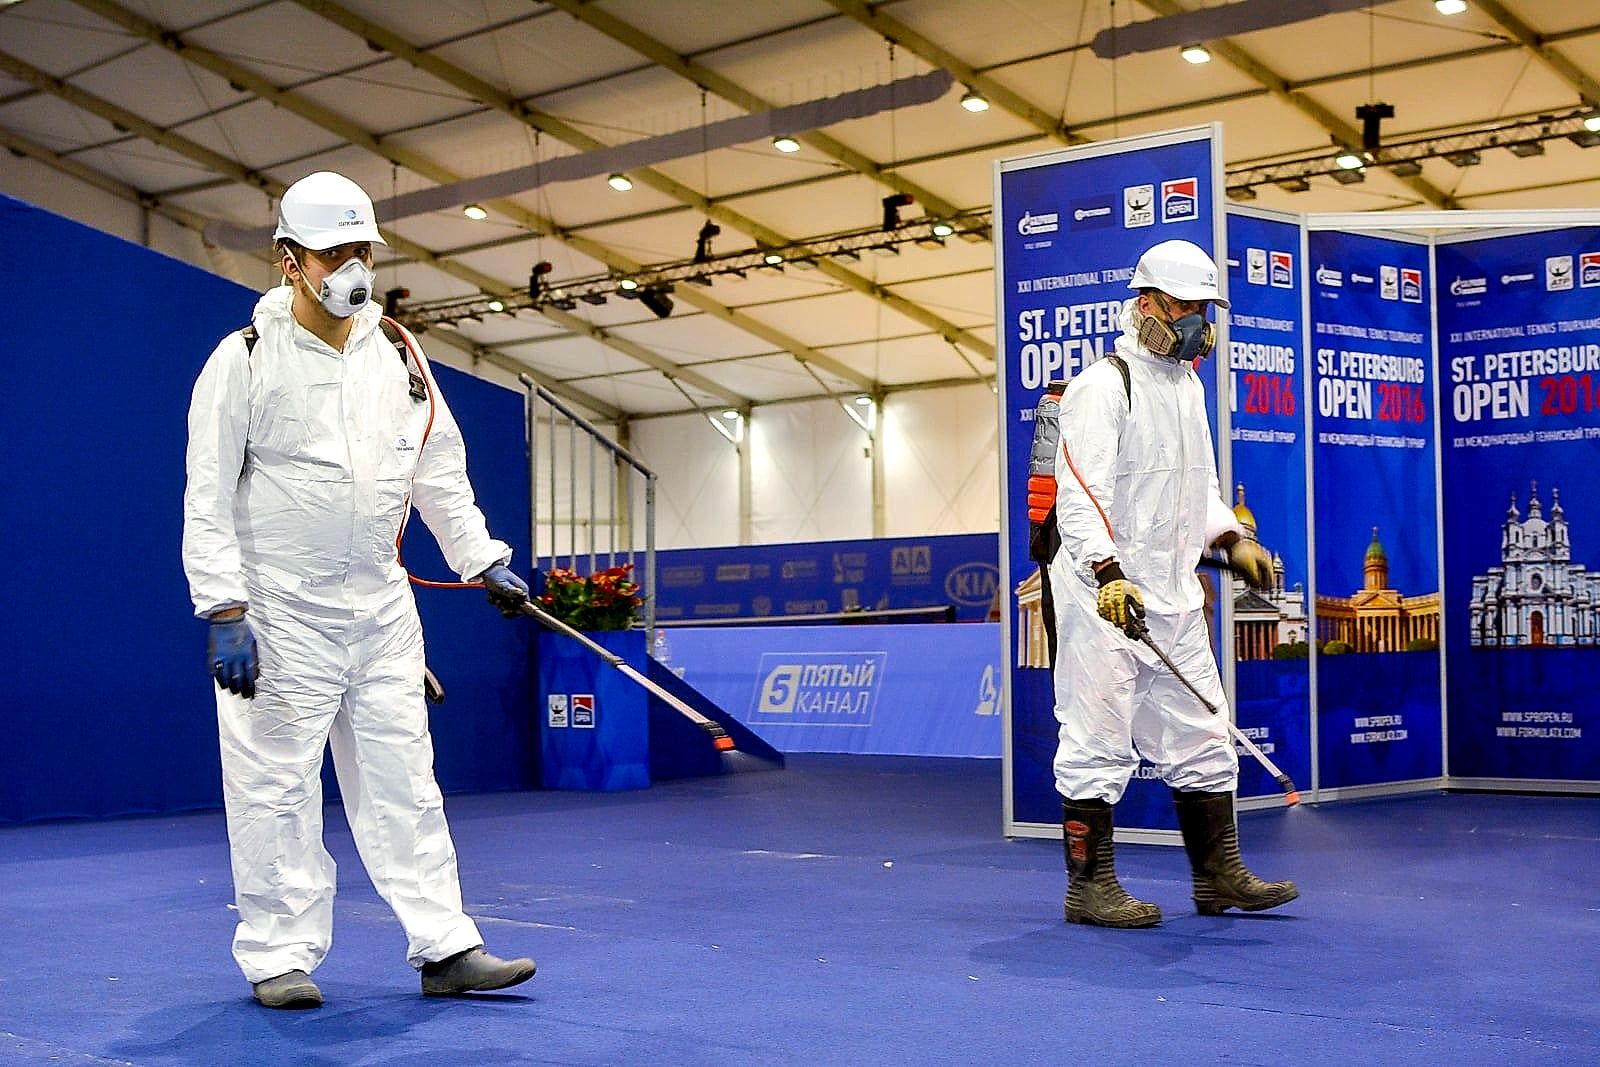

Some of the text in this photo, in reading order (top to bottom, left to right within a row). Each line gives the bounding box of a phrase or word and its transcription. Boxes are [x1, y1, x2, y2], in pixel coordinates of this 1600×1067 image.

[1129, 211, 1152, 222] ATP
[1167, 204, 1192, 216] OPEN
[1033, 272, 1100, 291] INTERNATIONAL
[1102, 267, 1135, 283] TENNIS
[1019, 309, 1050, 342] ST.
[1464, 326, 1525, 342] INTERNATIONAL
[1527, 322, 1556, 336] TENNIS
[1317, 348, 1425, 384] ST. PETERSBURG
[1451, 355, 1481, 383] ST.
[1244, 373, 1296, 416] 2016
[1318, 377, 1426, 424] OPEN 2016
[1453, 379, 1530, 422] OPEN
[956, 571, 997, 596] KIA
[771, 659, 876, 705] 5 ПЯТЫЙ
[796, 691, 871, 715] КАНАЛ
